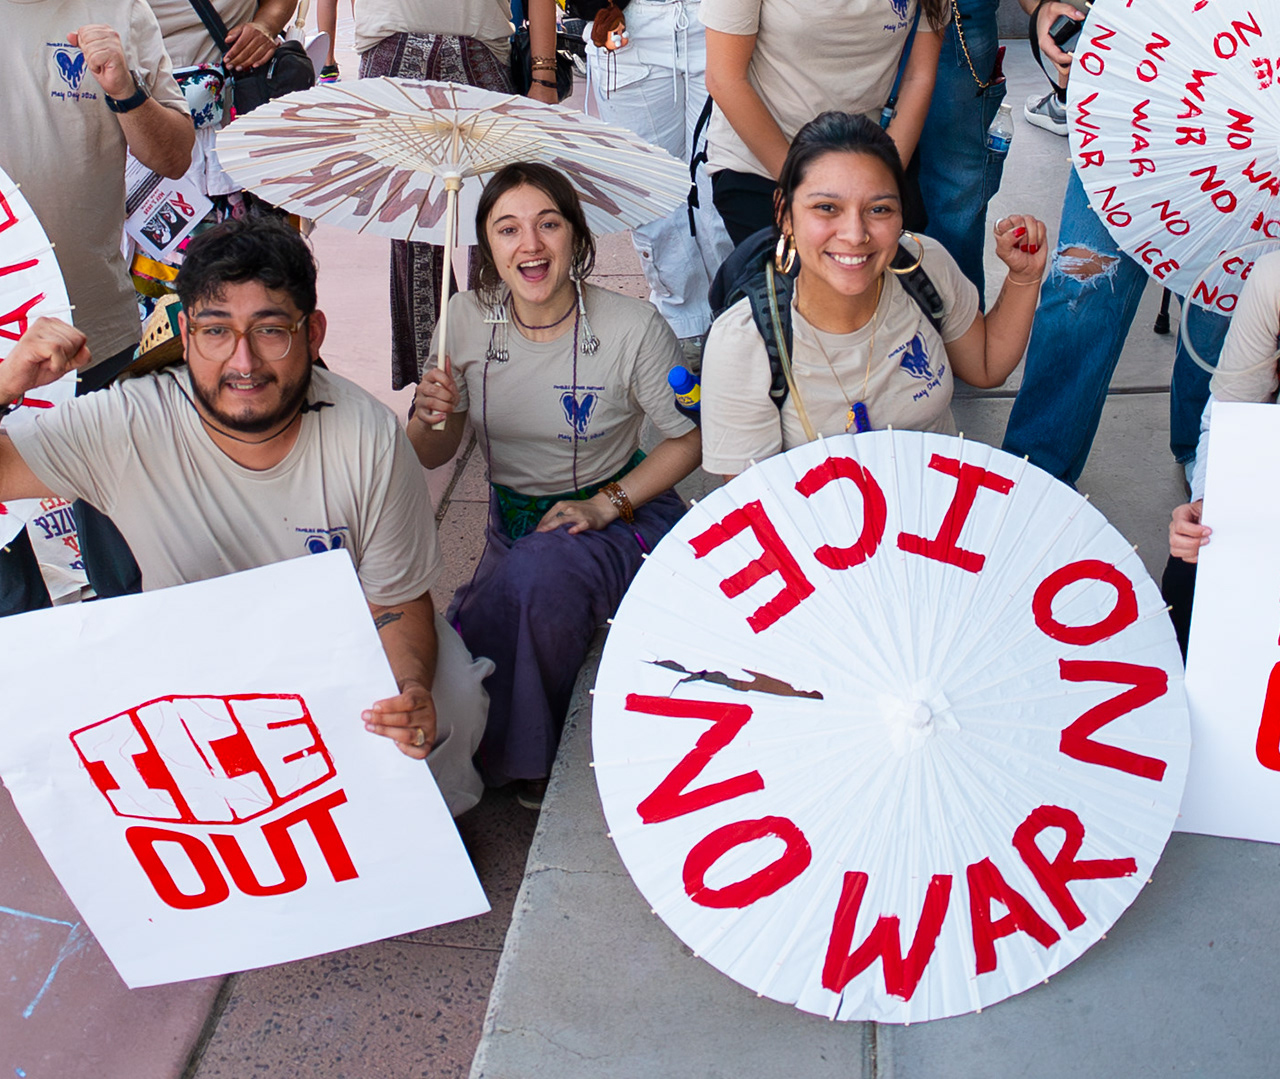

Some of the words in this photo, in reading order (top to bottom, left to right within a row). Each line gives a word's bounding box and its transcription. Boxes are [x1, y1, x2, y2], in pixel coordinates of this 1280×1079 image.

[1079, 23, 1118, 77] NO
[1135, 32, 1171, 84] NO
[1212, 11, 1263, 60] NO
[51, 90, 65, 101] May
[67, 90, 79, 102] Day
[81, 92, 97, 100] 2026
[1175, 68, 1217, 147] WAR
[1075, 92, 1106, 170] WAR
[1131, 99, 1156, 179] WAR
[1226, 108, 1254, 151] NO
[1094, 185, 1133, 229] NO
[1190, 165, 1237, 214] NO
[1152, 199, 1190, 236] NO
[1133, 241, 1180, 281] ICE
[1193, 280, 1239, 313] NO
[913, 389, 929, 402] May
[688, 453, 1017, 634] ICE
[1033, 559, 1169, 782] NO
[68, 692, 338, 826] ICE
[624, 693, 813, 910] NO
[125, 788, 359, 910] OUT
[821, 805, 1139, 1003] WAR
